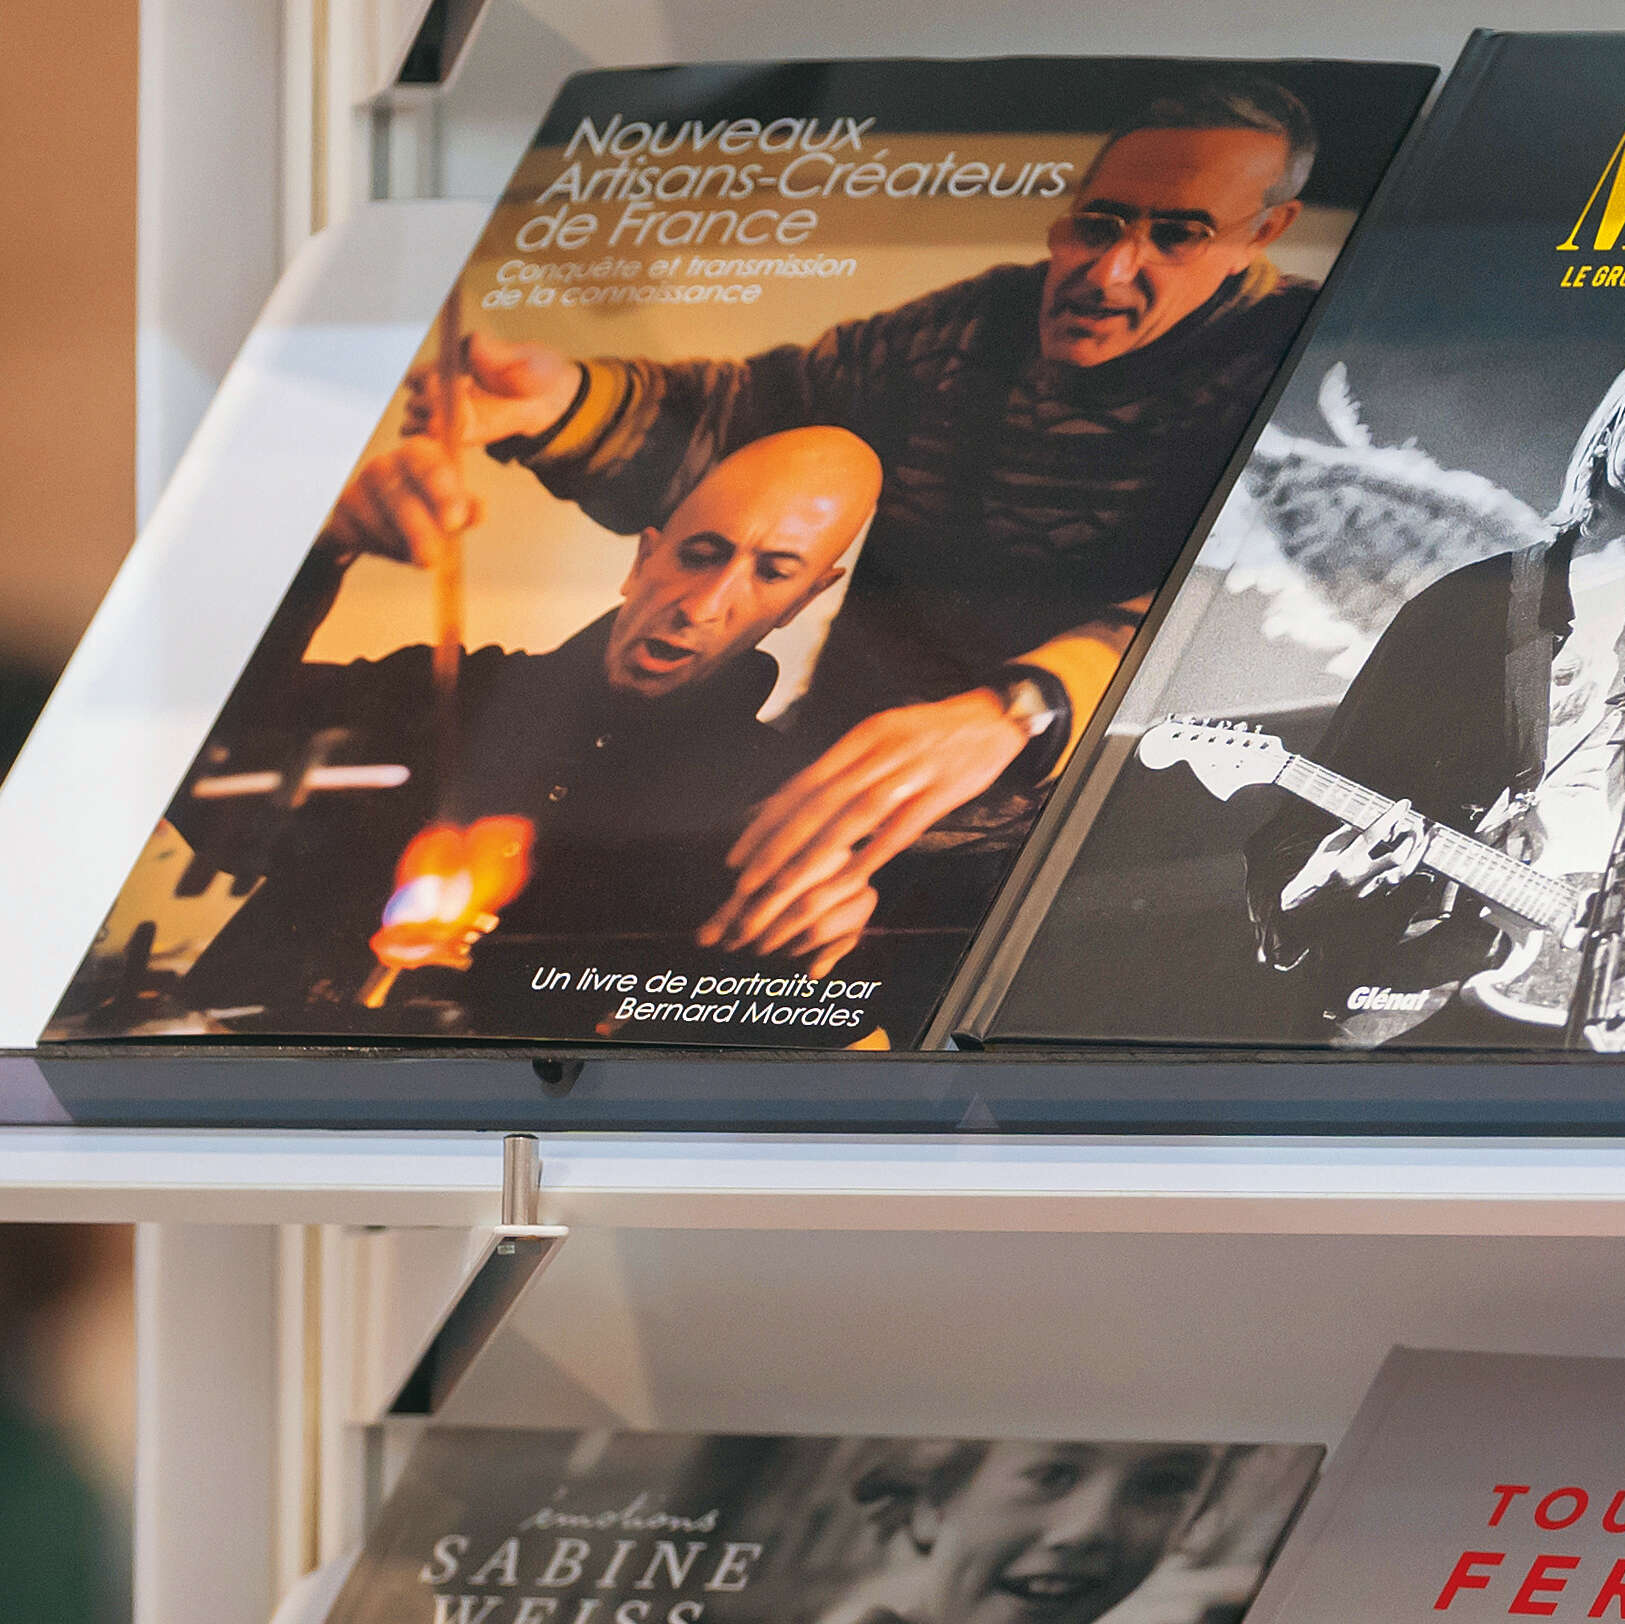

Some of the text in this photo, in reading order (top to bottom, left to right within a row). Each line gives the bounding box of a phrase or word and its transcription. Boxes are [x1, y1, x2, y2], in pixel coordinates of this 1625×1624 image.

[563, 113, 876, 159] Nouveaux
[536, 149, 1075, 203] Artisans-Créateurs
[515, 201, 819, 252] de France
[495, 253, 857, 285] Conquête et transmission
[1560, 265, 1591, 288] LE
[481, 282, 763, 310] de la connaissance
[530, 966, 882, 1004] Un livre de portraits par
[1346, 986, 1431, 1011] Glénat
[614, 996, 865, 1028] Bernard Morales
[417, 1534, 764, 1593] SABINE
